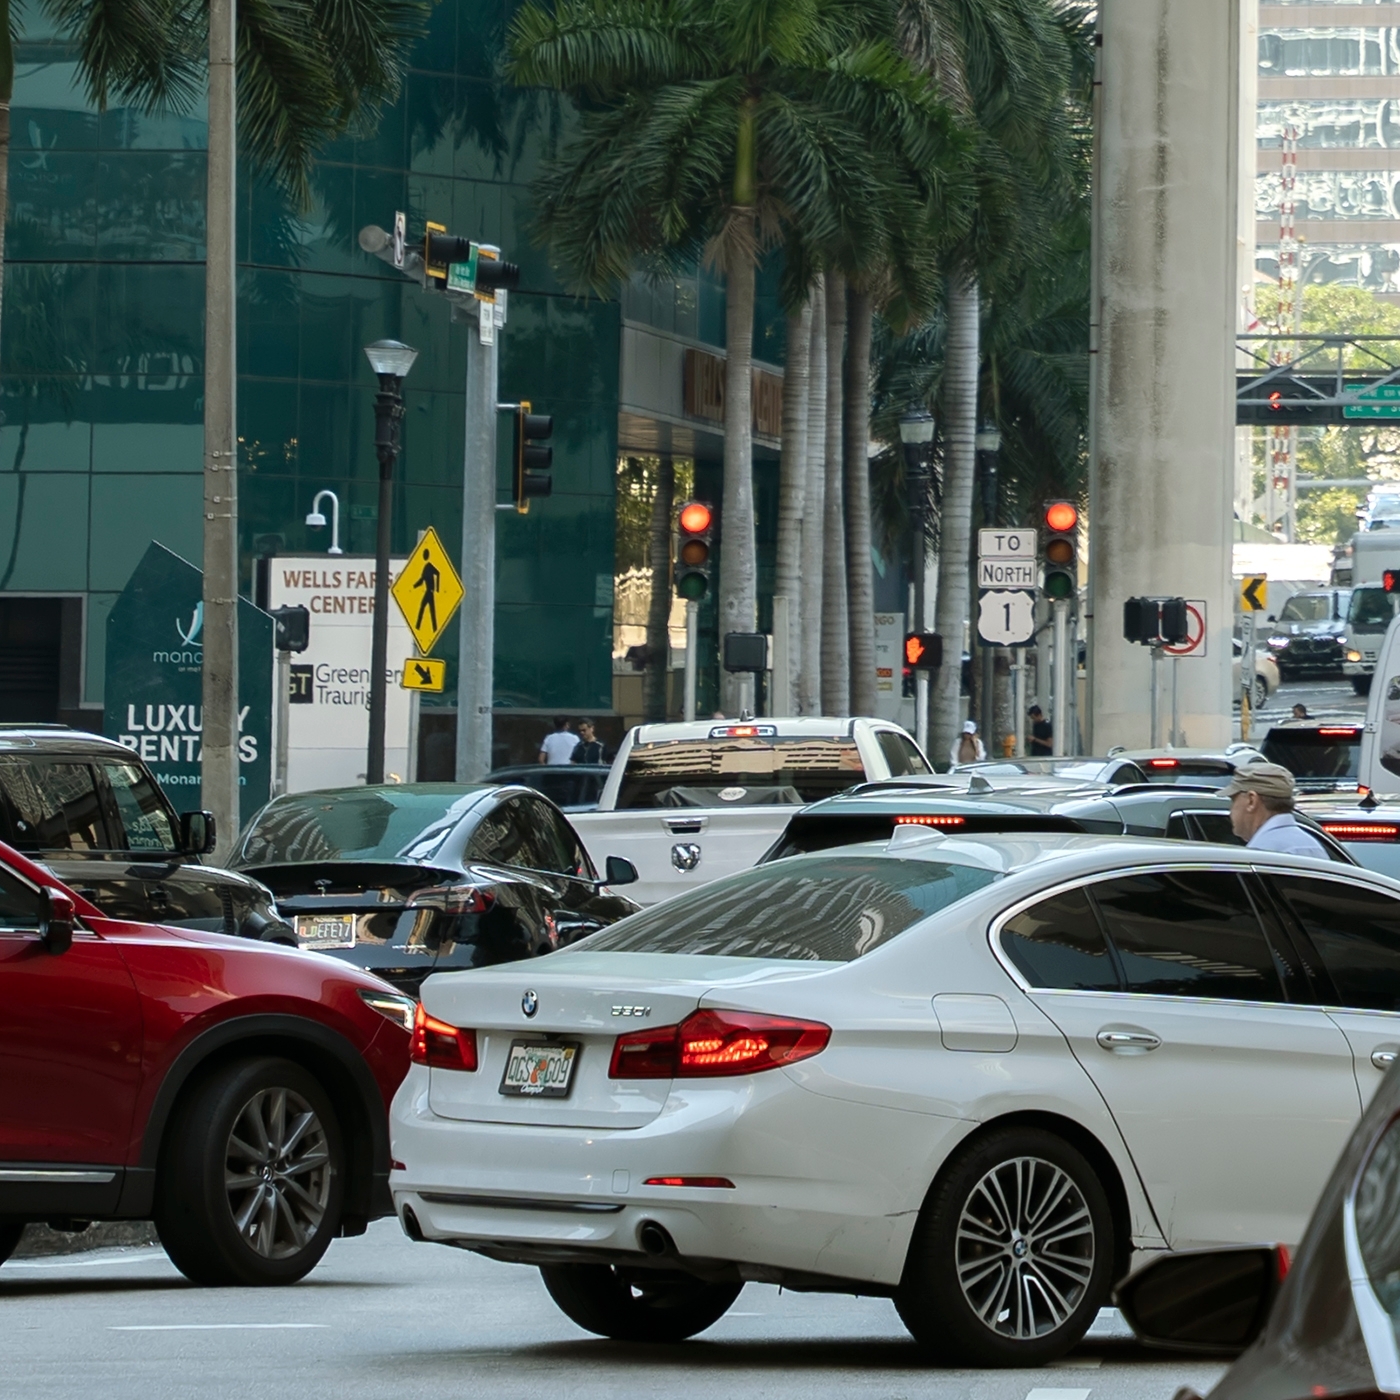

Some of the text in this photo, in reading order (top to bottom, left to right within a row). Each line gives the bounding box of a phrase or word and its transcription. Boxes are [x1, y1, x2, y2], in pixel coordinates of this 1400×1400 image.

[994, 535, 1021, 551] TO
[283, 570, 342, 588] WELLS
[982, 564, 1033, 583] NORTH
[1003, 603, 1011, 632] 1
[127, 704, 251, 732] LUXUY
